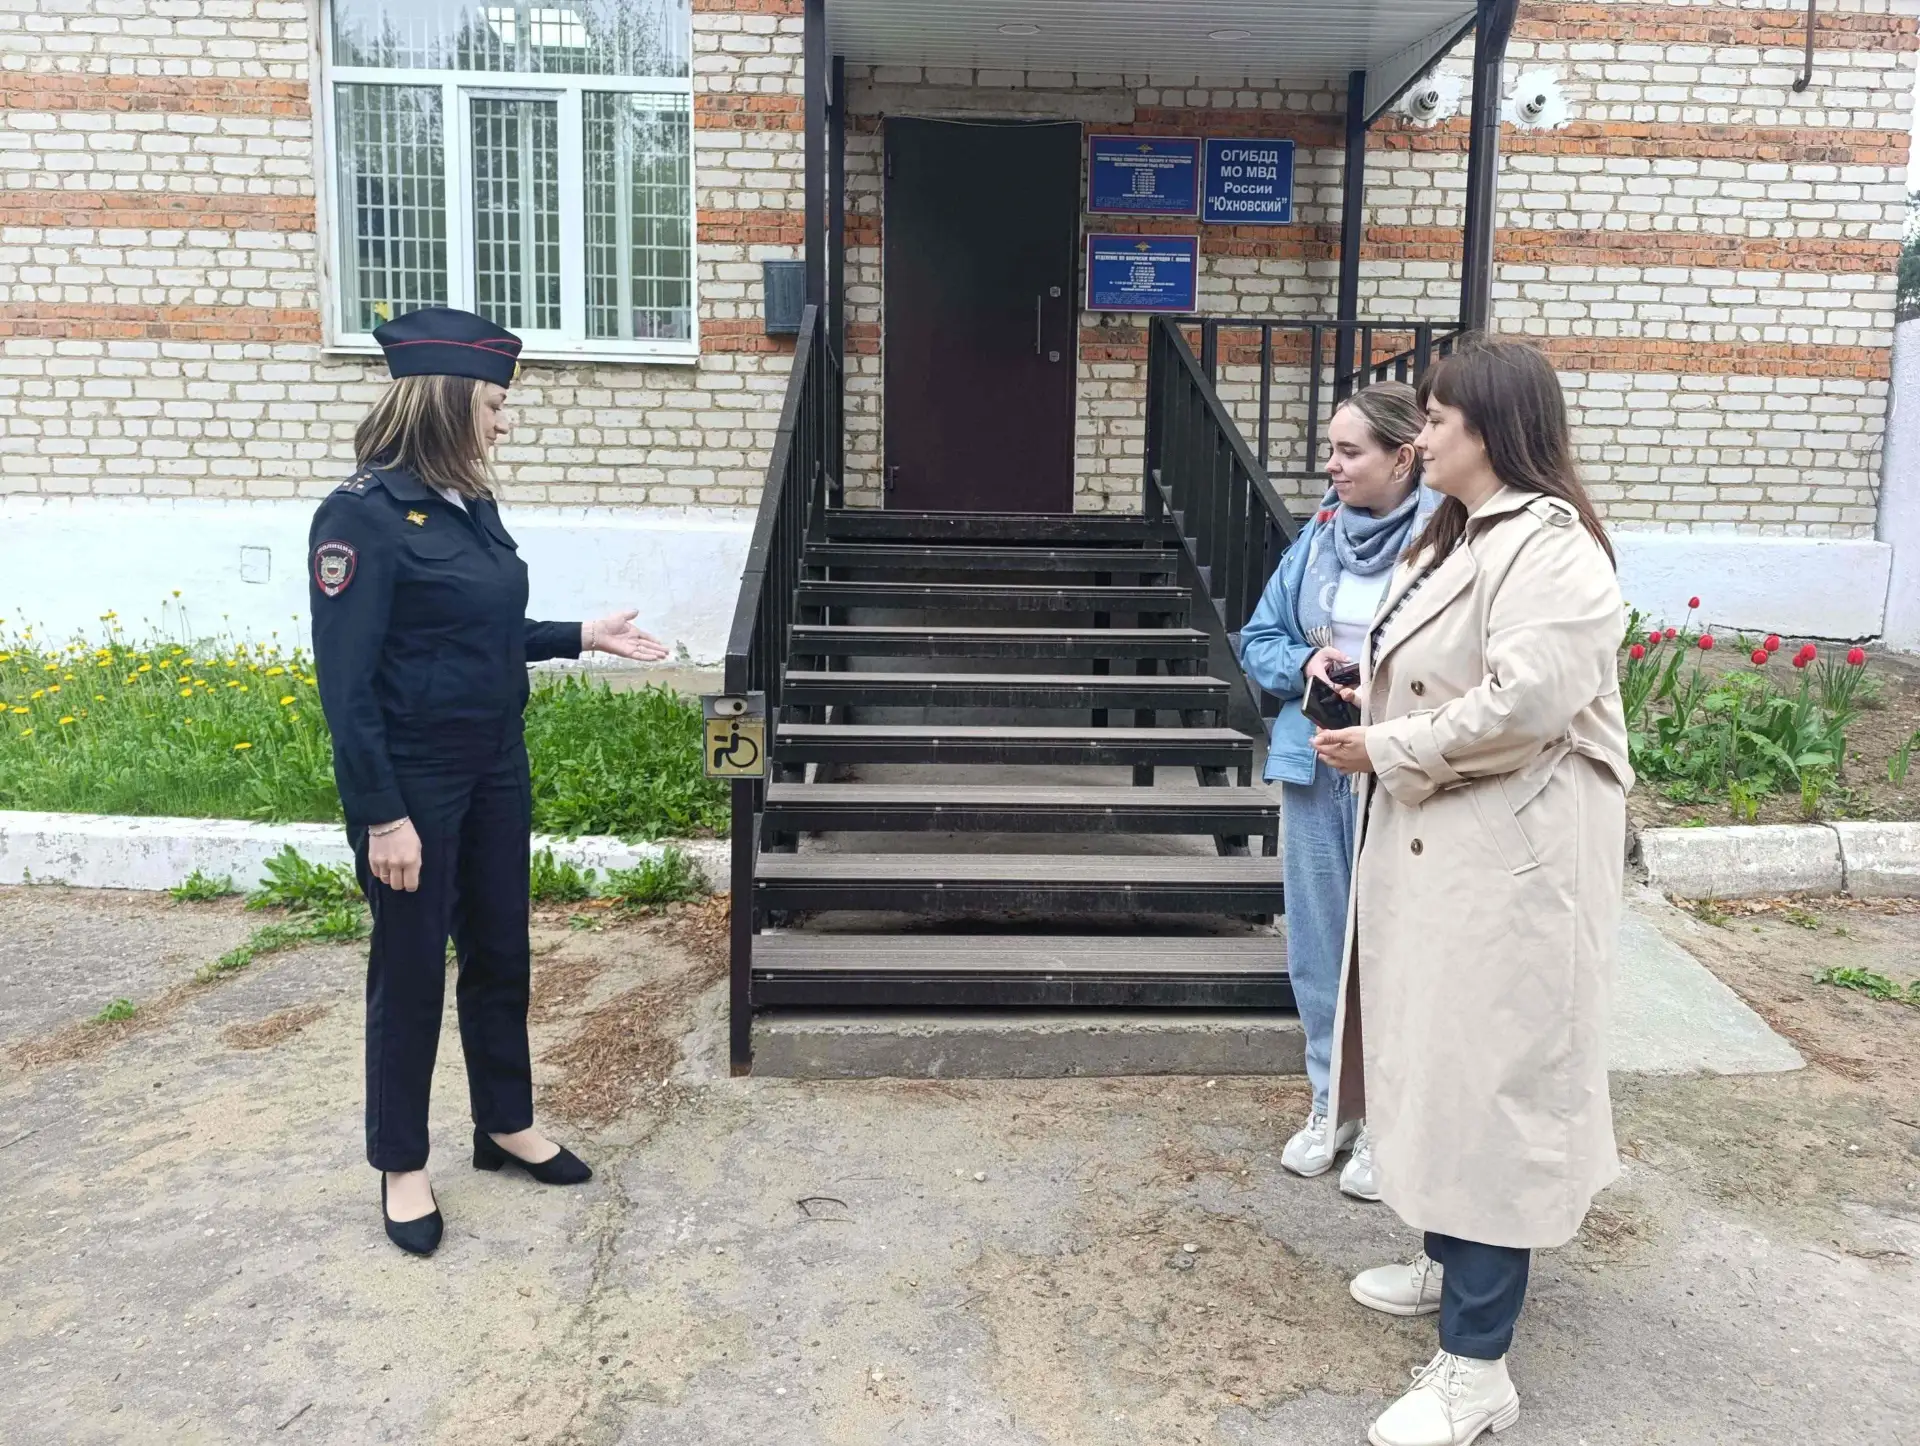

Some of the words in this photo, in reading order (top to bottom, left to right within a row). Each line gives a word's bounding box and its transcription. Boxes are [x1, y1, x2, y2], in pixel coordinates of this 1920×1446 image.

[1220, 149, 1278, 164] ОГИБДД
[1220, 166, 1242, 177] МО
[1246, 166, 1277, 180] МВД
[1224, 181, 1273, 194] России
